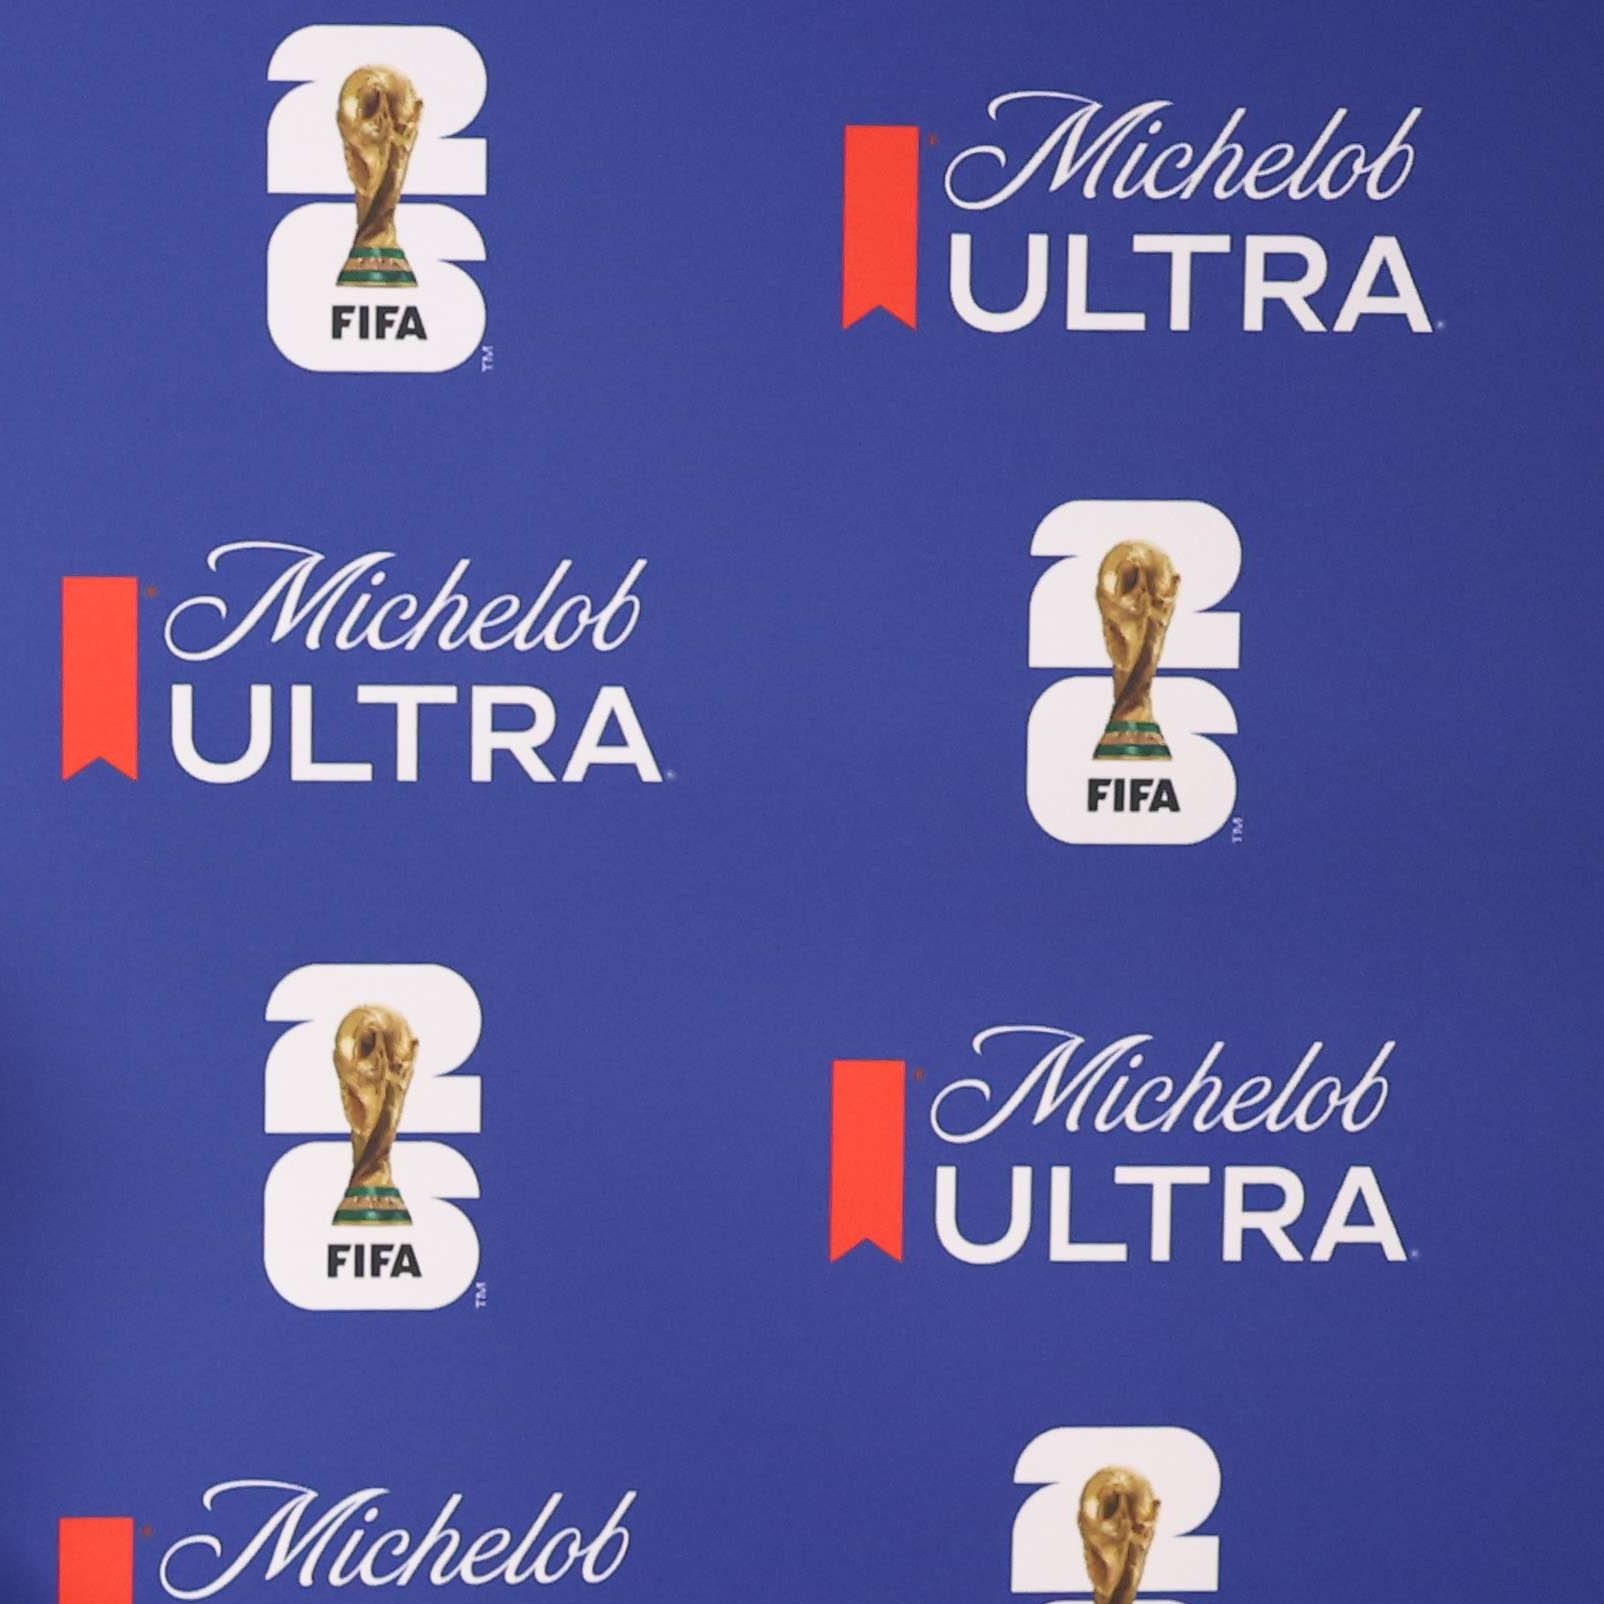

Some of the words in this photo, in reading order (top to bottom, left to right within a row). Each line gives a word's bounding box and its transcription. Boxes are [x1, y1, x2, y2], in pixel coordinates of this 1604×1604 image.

[945, 91, 1421, 209] Michelob
[332, 305, 427, 340] FIFA
[950, 233, 1432, 332] ULTRA
[165, 541, 647, 660] Michelob
[172, 684, 662, 783] ULTRA
[1088, 778, 1180, 812] FIFA
[931, 1026, 1395, 1143] Michelob
[328, 1244, 422, 1278] FIFA
[936, 1166, 1406, 1264] ULTRA
[160, 1480, 636, 1599] Michelob
